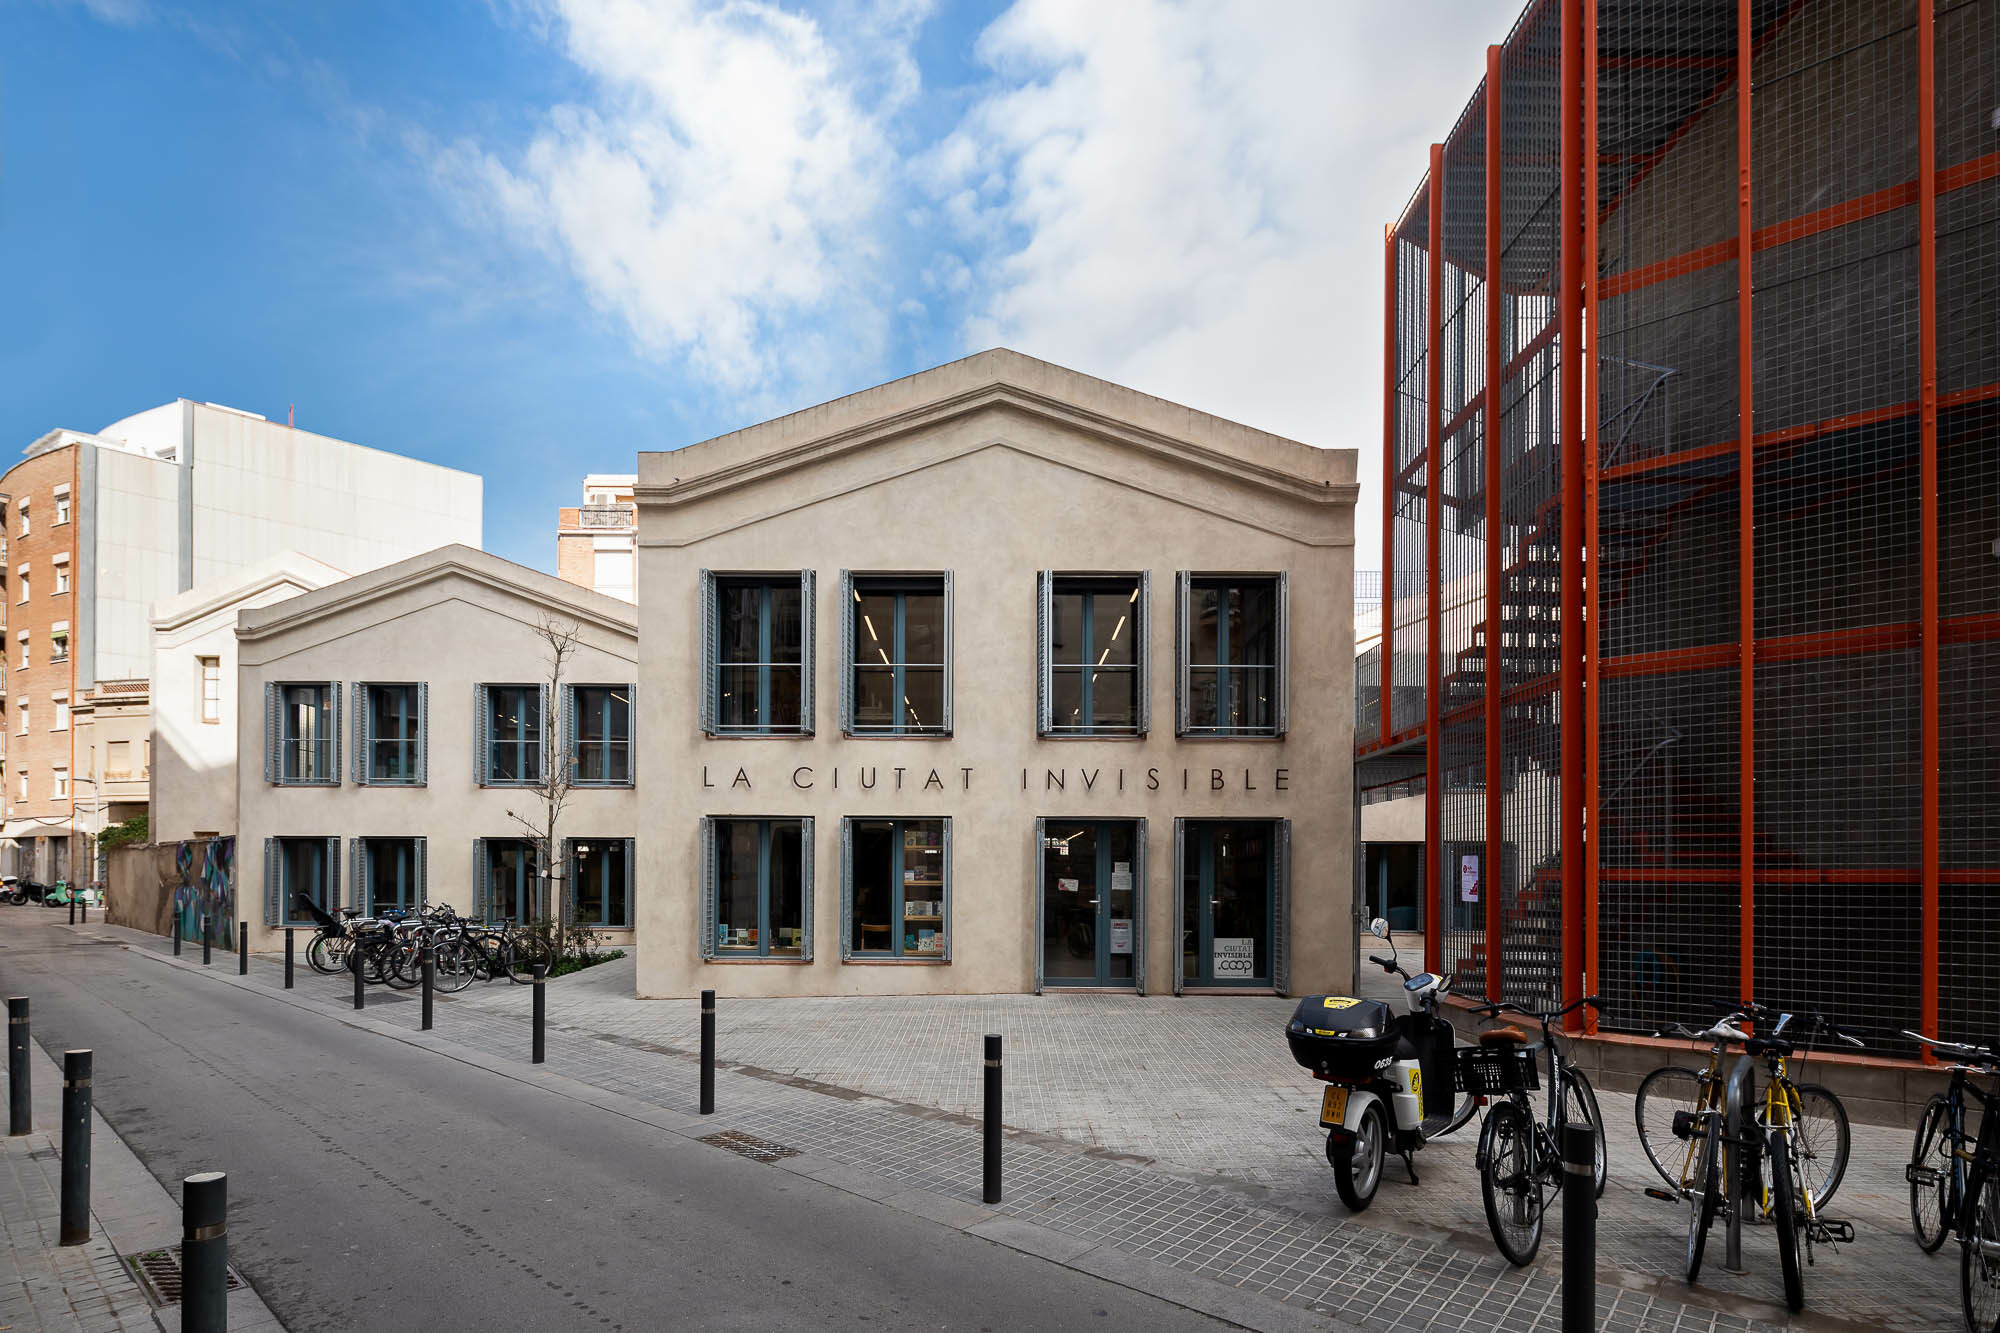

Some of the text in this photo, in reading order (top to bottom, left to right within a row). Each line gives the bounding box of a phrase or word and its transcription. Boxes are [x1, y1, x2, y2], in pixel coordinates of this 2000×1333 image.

[703, 766, 1290, 791] LA CIUTAT INVISIBLE
